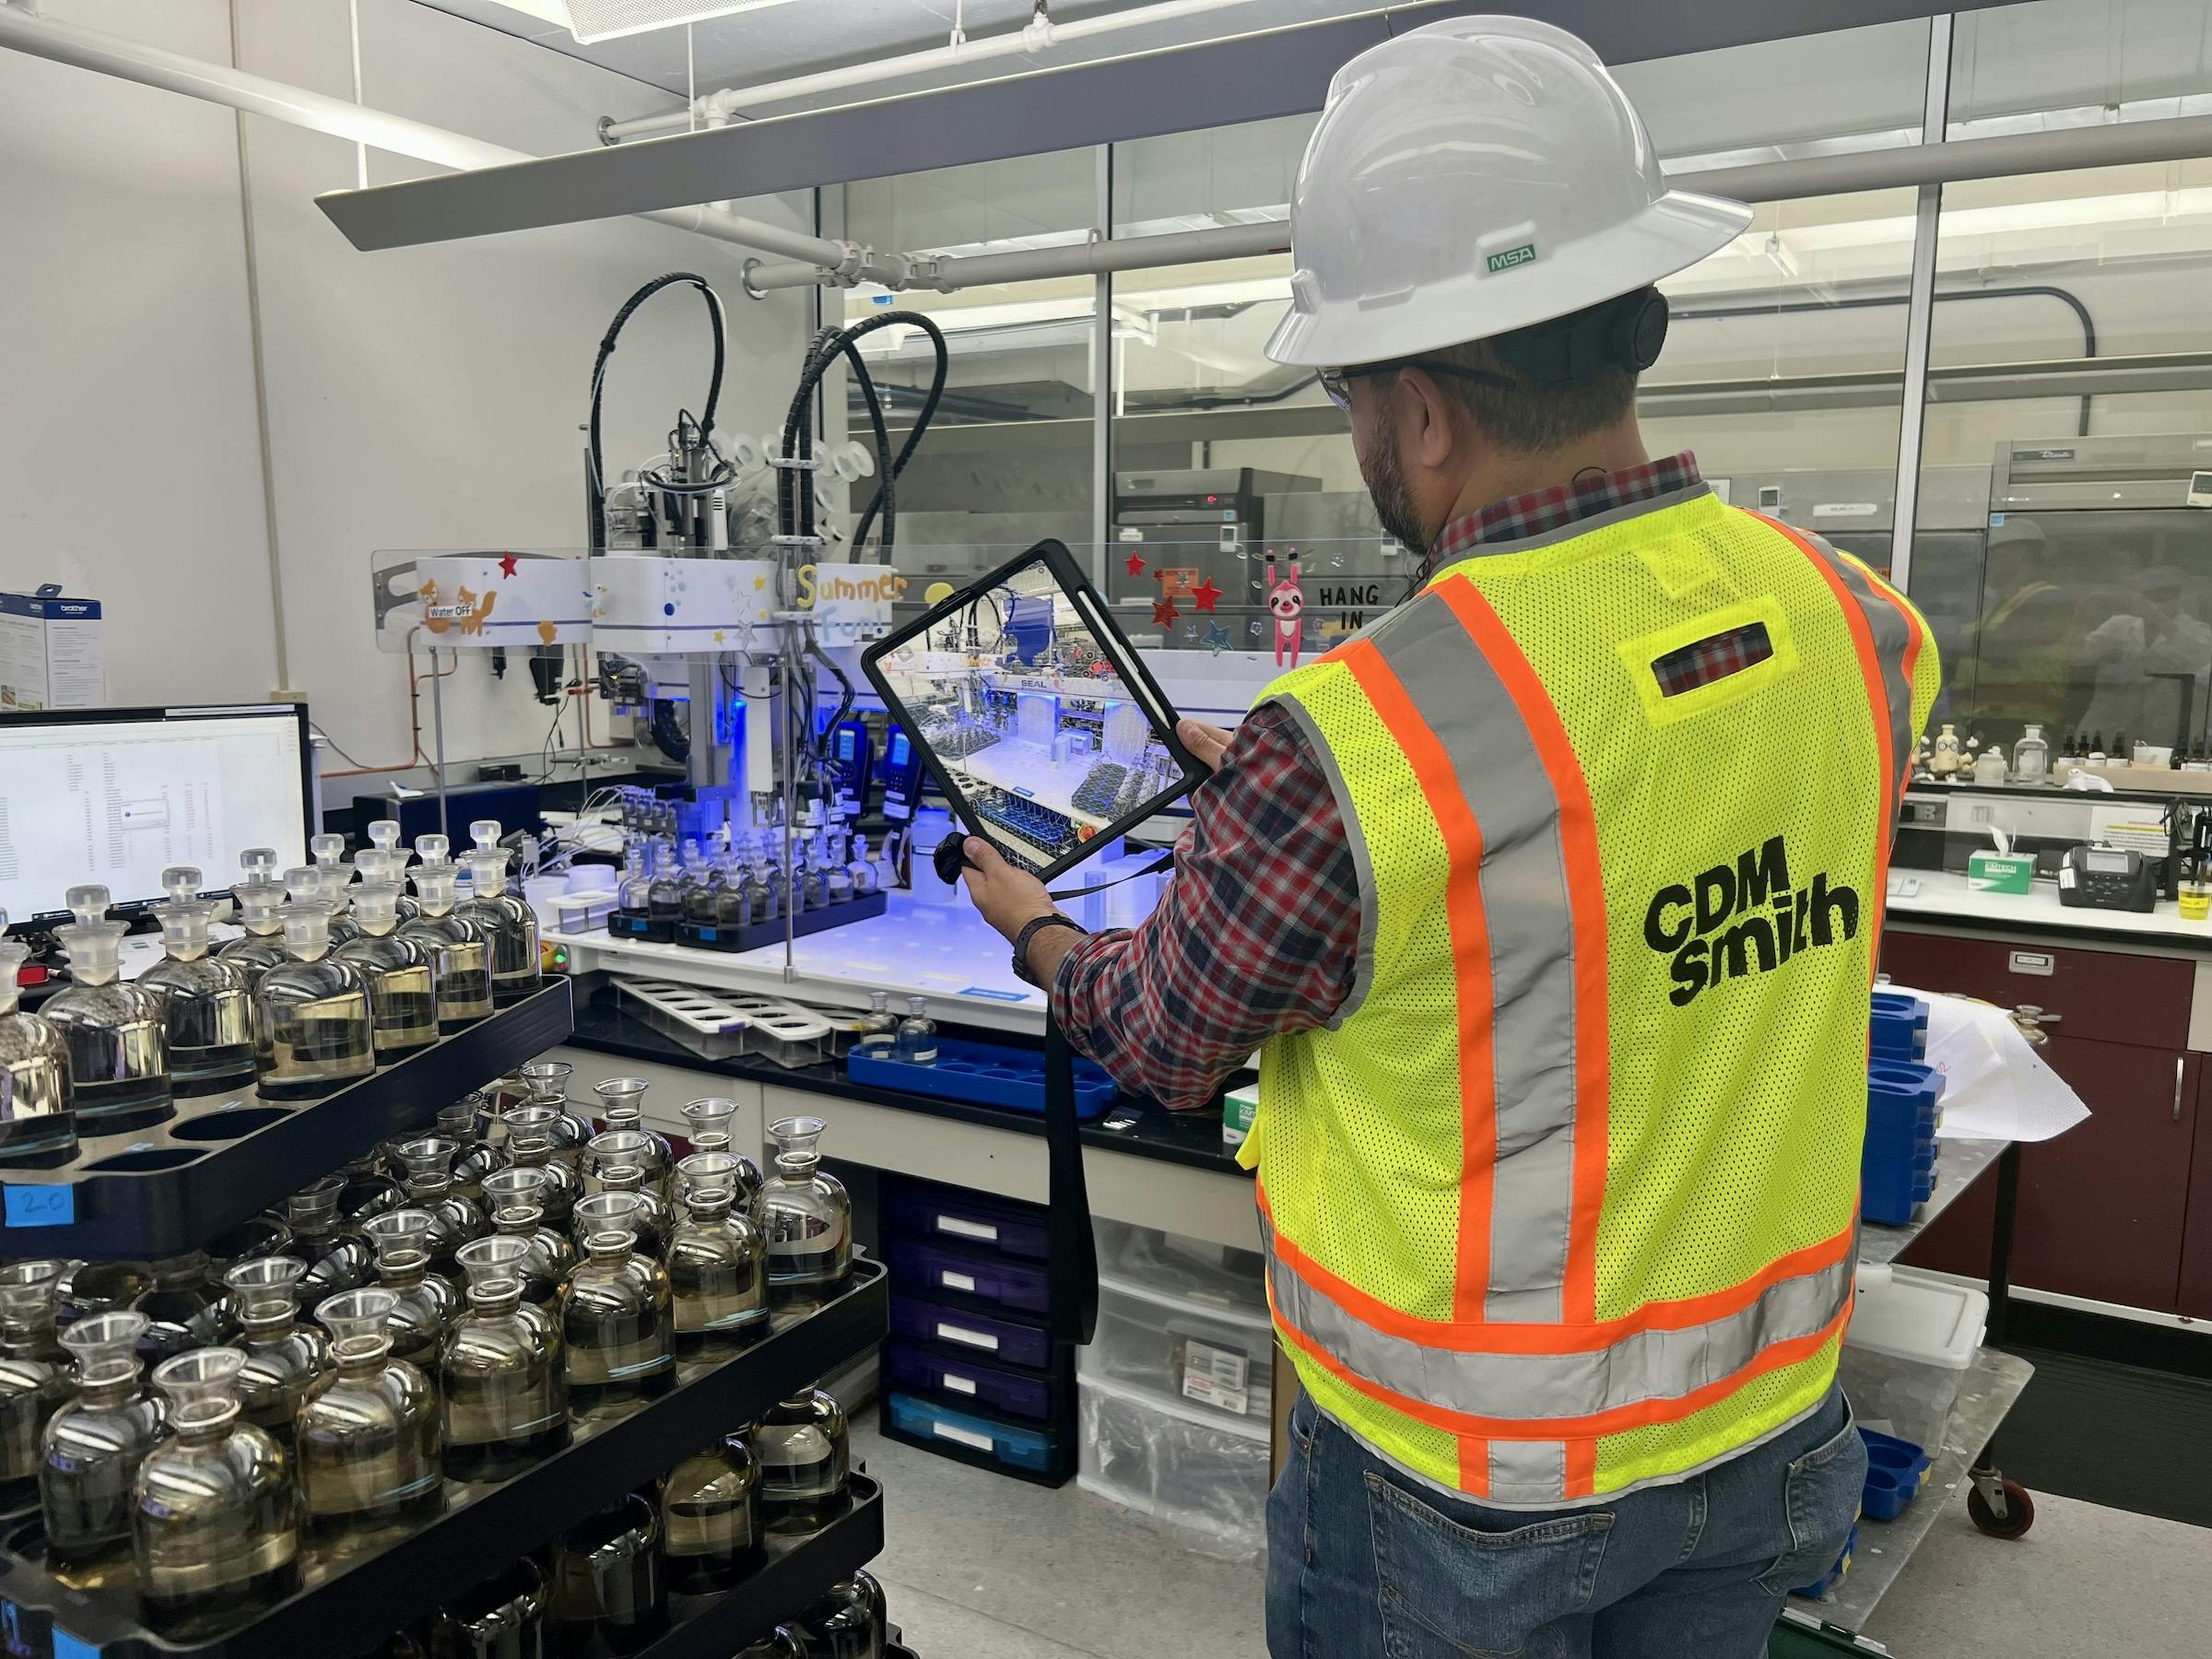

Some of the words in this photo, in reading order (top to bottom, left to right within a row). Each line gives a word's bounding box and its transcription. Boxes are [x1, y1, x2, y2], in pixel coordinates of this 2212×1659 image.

[1490, 247, 1534, 270] MSA
[796, 564, 909, 608] Summer
[1319, 584, 1380, 606] HANG
[430, 607, 454, 617] Water
[455, 604, 471, 616] OFF
[1341, 610, 1364, 630] IN
[1021, 679, 1047, 688] SEAL
[1643, 835, 1791, 954] CDM
[20, 1191, 65, 1213] 20
